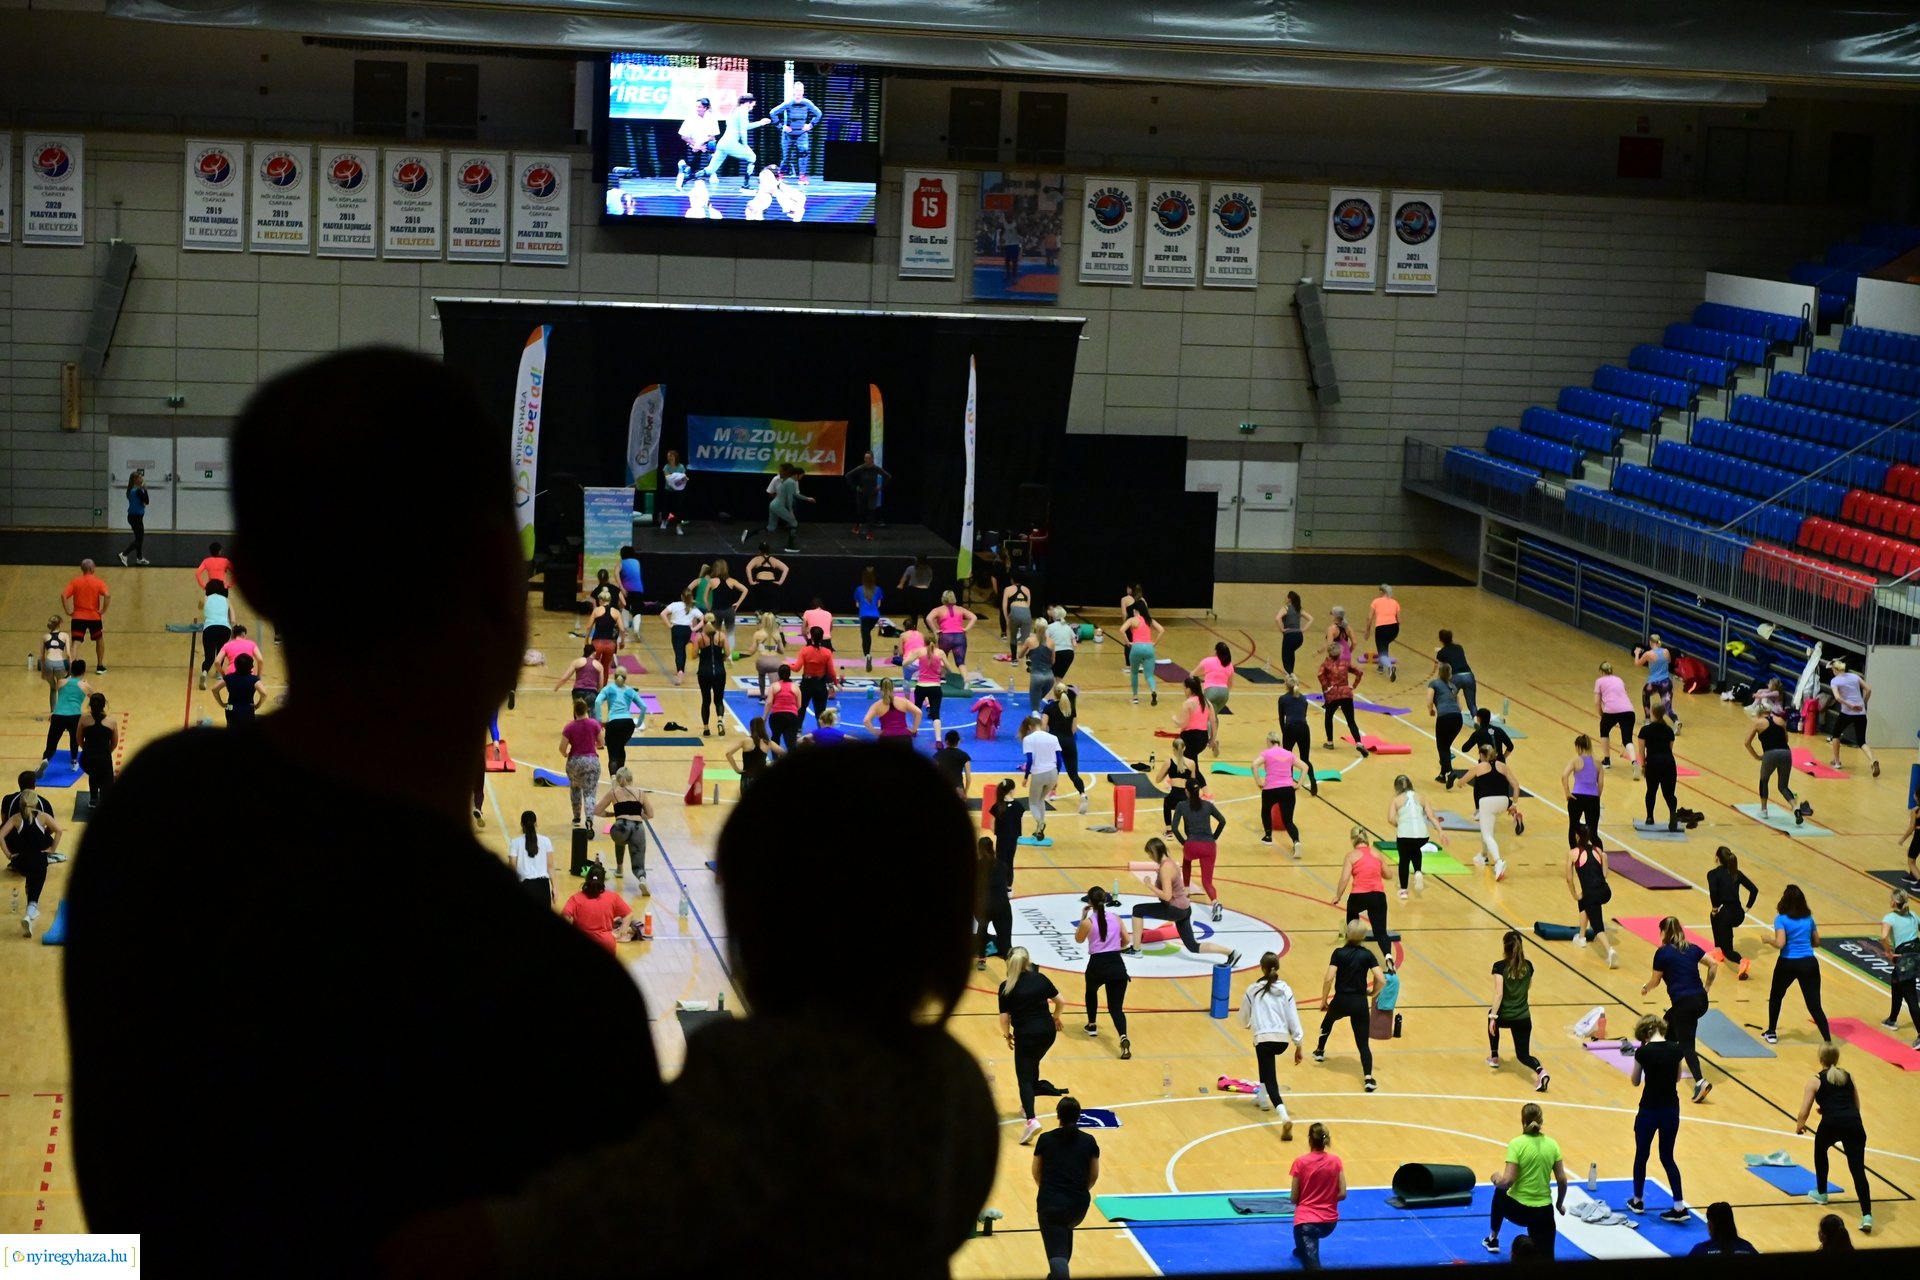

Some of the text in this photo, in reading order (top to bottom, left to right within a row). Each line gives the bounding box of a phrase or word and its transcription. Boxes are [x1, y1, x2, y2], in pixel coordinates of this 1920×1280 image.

[59, 211, 76, 219] KUPA
[921, 197, 938, 217] 15
[286, 220, 303, 228] KUPA
[696, 443, 837, 464] NYÍREGYHÁZA
[1019, 908, 1084, 961] NYÍREGYHÁZA
